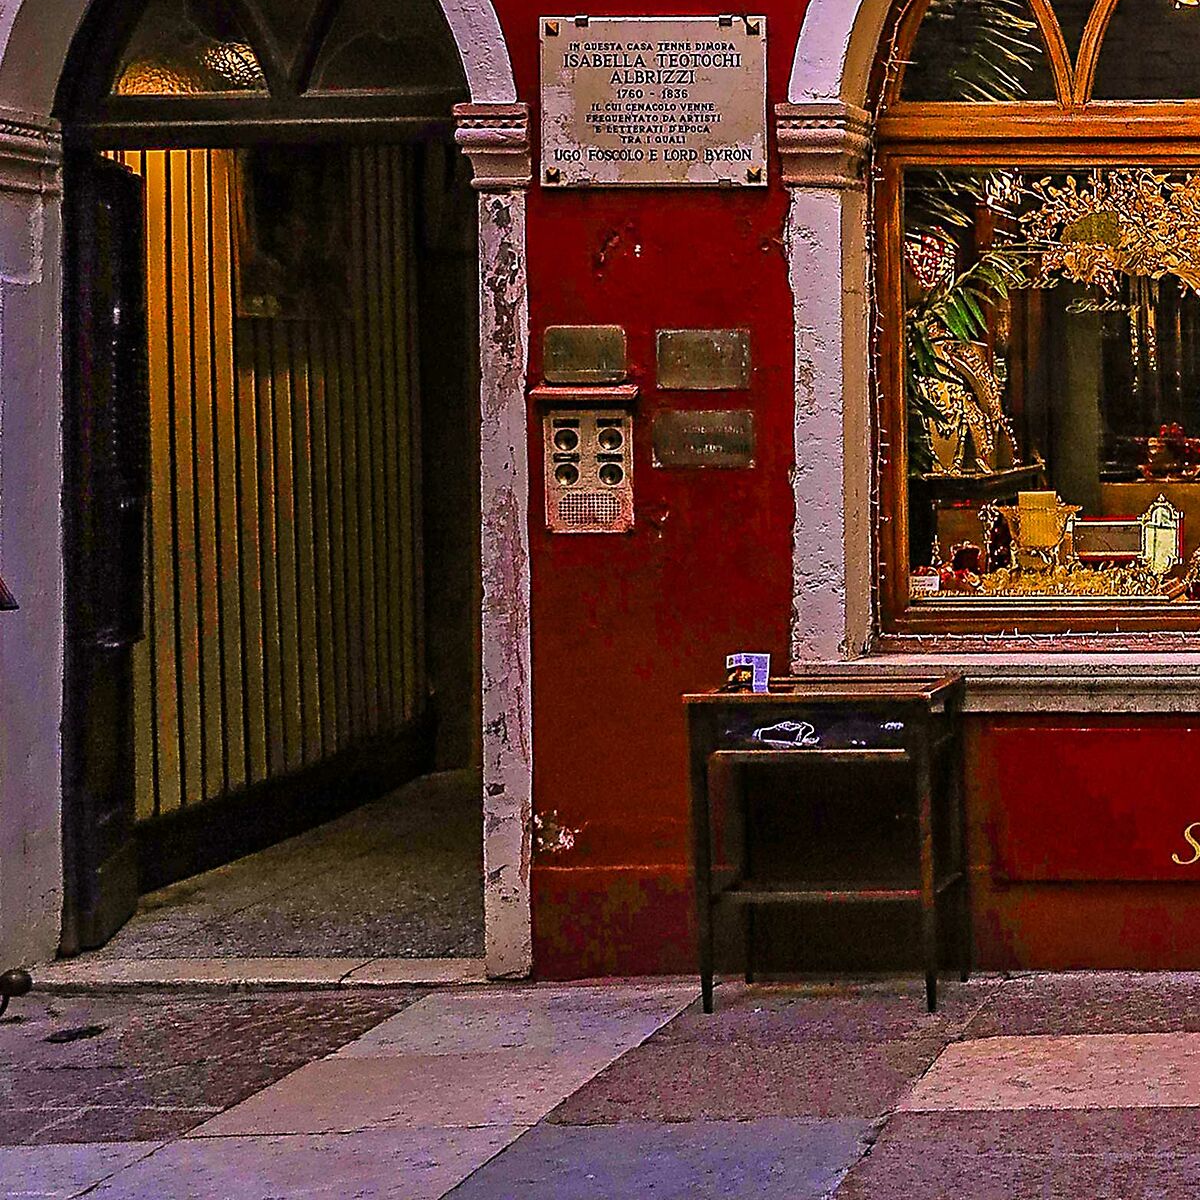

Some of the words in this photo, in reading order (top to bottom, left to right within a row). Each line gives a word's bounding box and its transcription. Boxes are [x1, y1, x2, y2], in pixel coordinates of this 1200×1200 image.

[569, 43, 581, 51] IN
[584, 42, 623, 51] QUESTA
[627, 42, 653, 51] CASA
[657, 42, 691, 51] TENNE
[695, 42, 736, 51] DIMORA
[563, 53, 647, 68] ISABELLA
[656, 53, 742, 68] TEOTOCHI
[610, 70, 695, 85] ALBRIZZI
[616, 89, 644, 99] 1760
[662, 89, 688, 99] 1836
[591, 103, 603, 112] IL
[605, 103, 622, 112] CUI
[625, 103, 677, 112] CENACOLO
[680, 103, 715, 112] VENNE
[585, 114, 659, 123] FREQUENTATO
[662, 114, 676, 123] DA
[680, 114, 721, 123] ARTISTI
[594, 125, 602, 134] E
[606, 125, 663, 134] LETTERATI
[668, 124, 710, 134] D'EPOCA
[620, 136, 642, 144] TRA
[654, 136, 686, 144] QUALI
[553, 149, 581, 161] UGO
[588, 149, 644, 161] FOSCOLO
[650, 149, 658, 161] E
[664, 149, 698, 161] LORD
[704, 149, 752, 161] BYRON
[1065, 297, 1143, 318] Gallery
